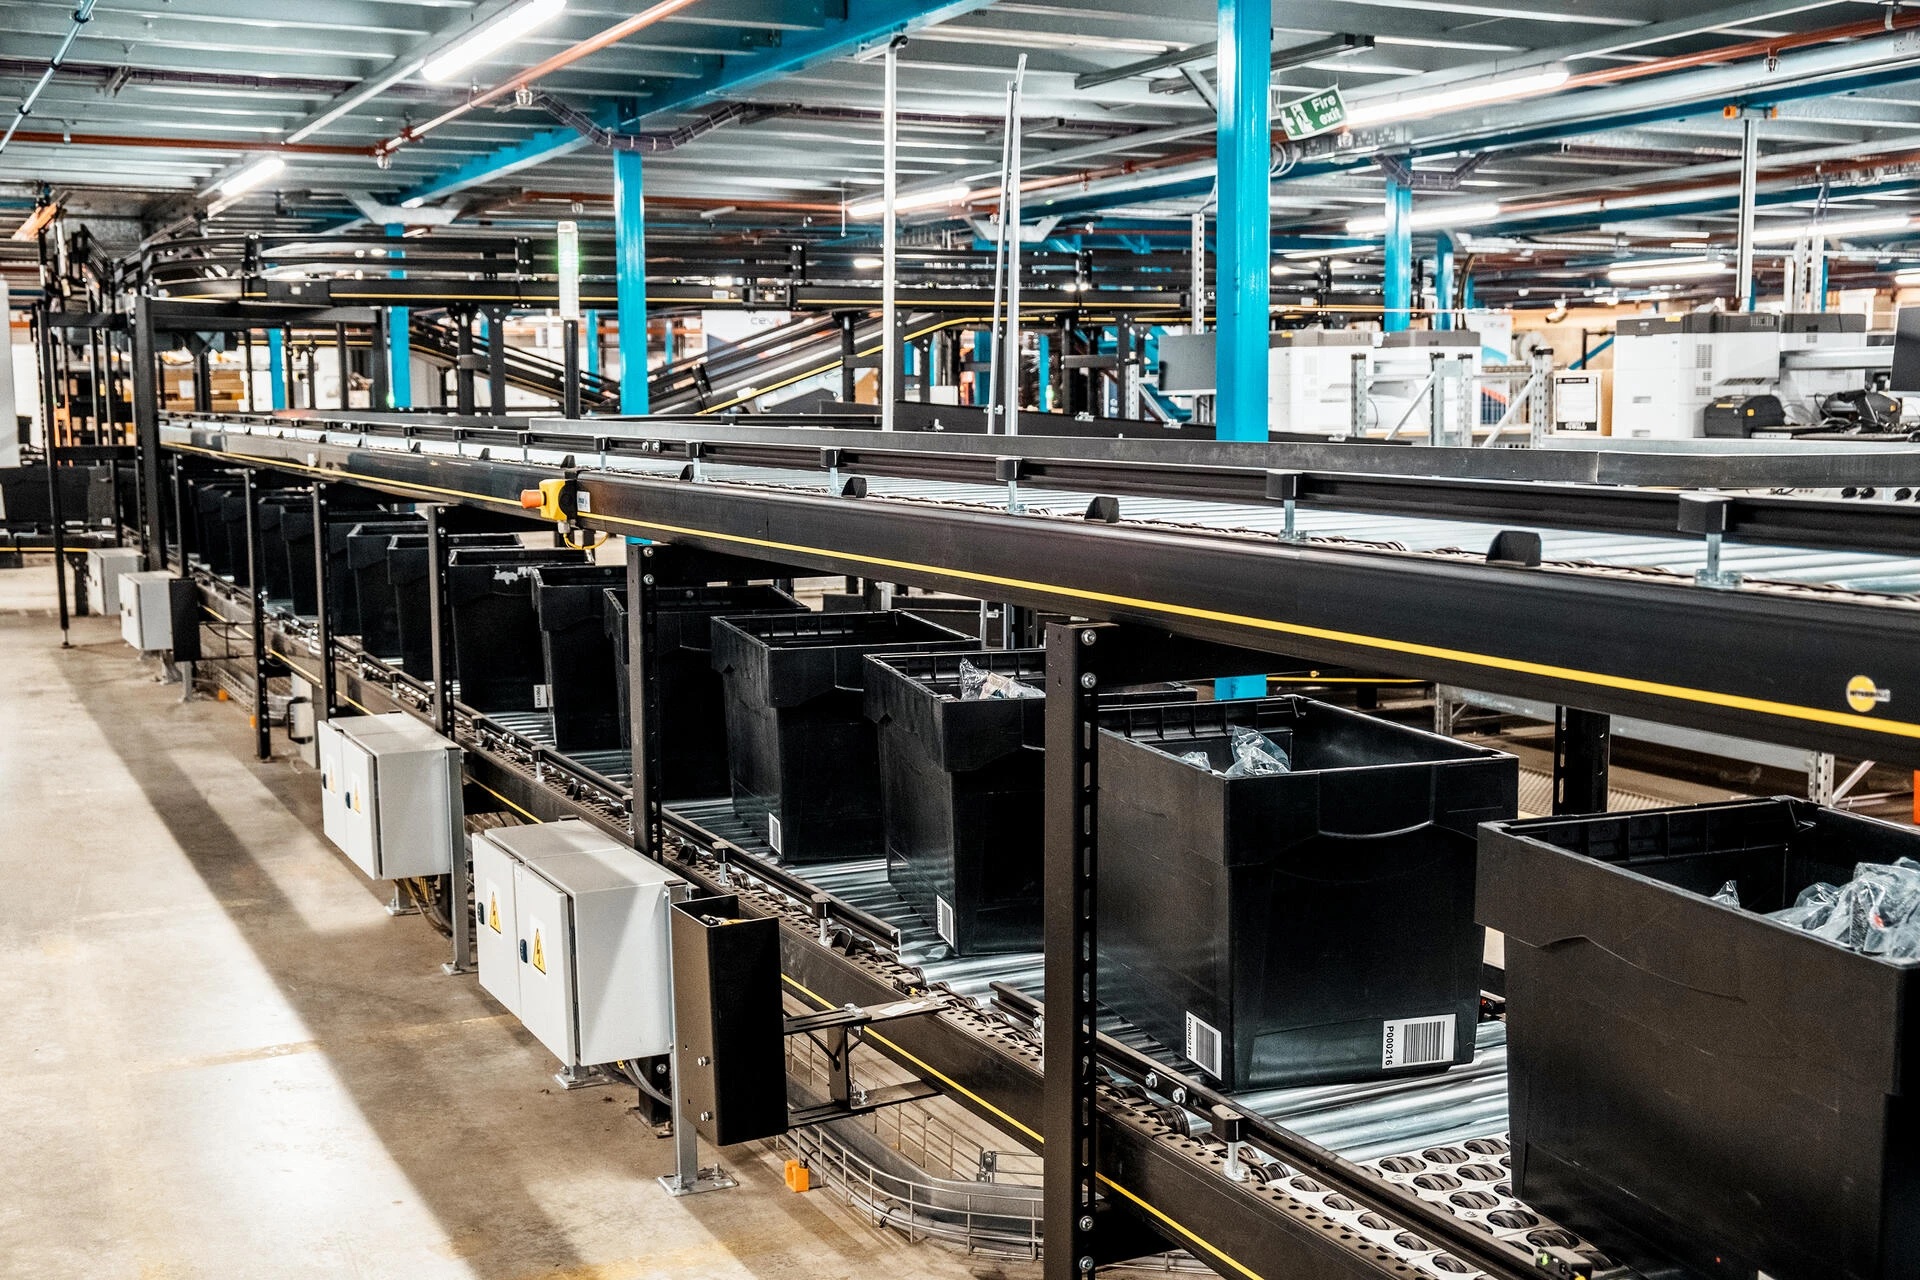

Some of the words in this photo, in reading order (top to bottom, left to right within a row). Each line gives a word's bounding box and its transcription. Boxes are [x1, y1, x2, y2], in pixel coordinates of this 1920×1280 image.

[1311, 95, 1337, 112] Fire
[1319, 107, 1342, 125] exit
[1385, 1025, 1395, 1066] P000216
